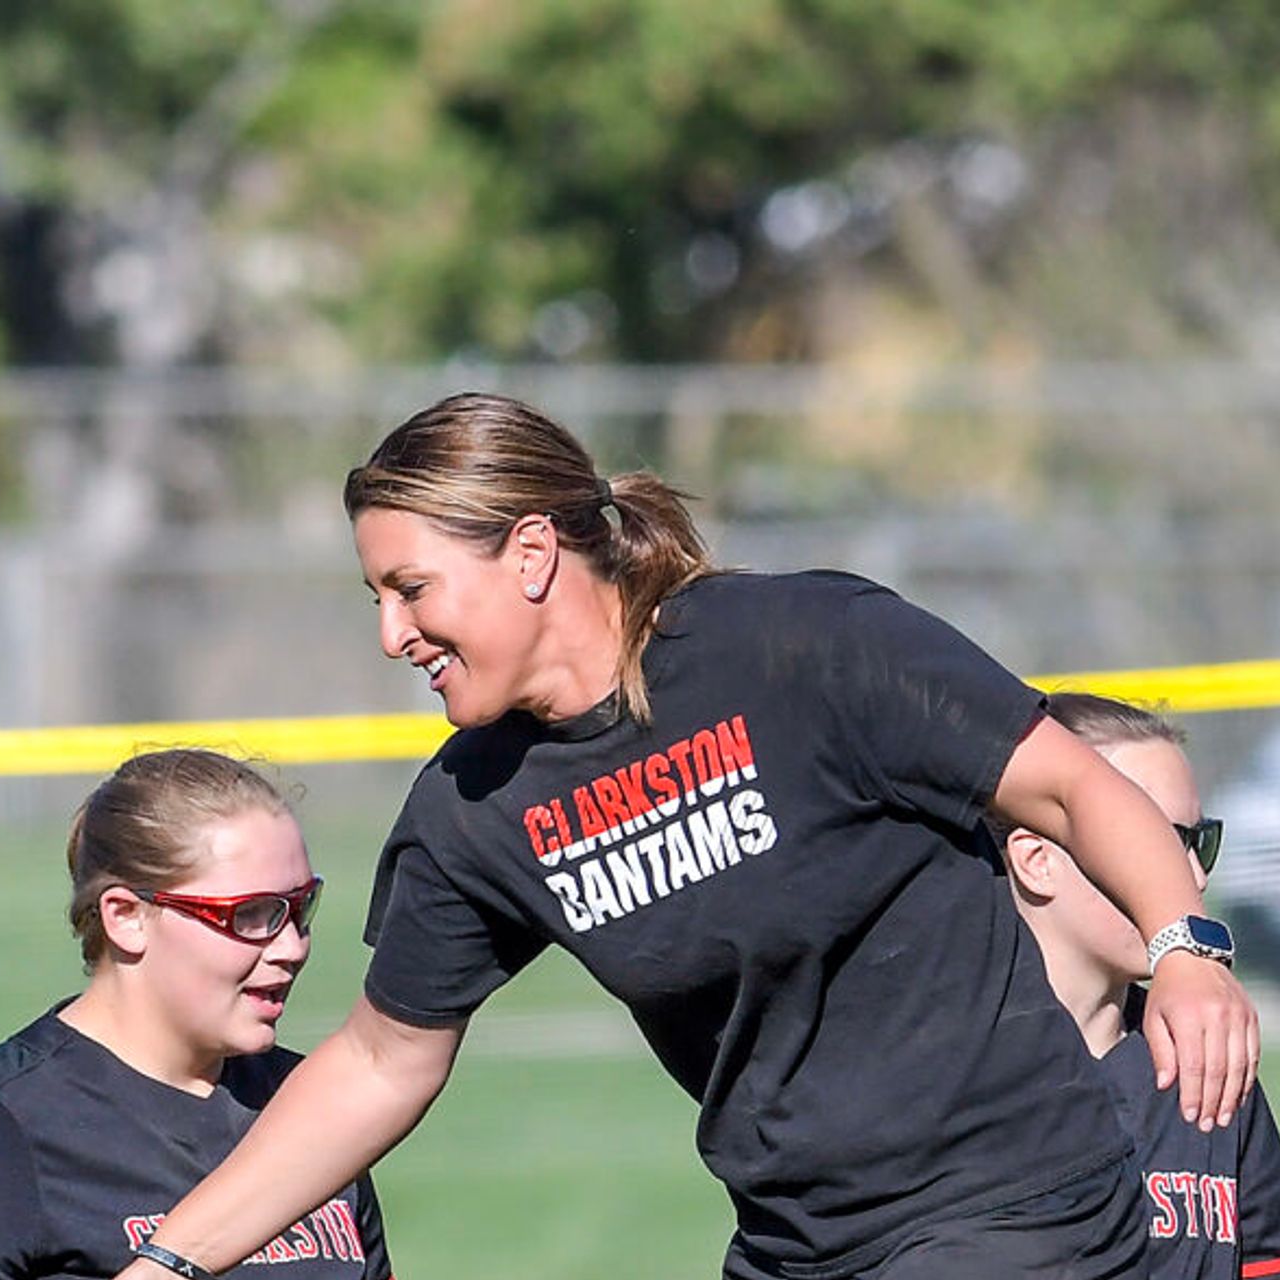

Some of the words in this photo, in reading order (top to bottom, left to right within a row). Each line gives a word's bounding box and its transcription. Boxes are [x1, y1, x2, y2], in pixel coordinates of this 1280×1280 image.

[524, 714, 757, 867] CLARKSTON
[545, 789, 778, 933] BANTAMS
[1142, 1171, 1238, 1244] STON
